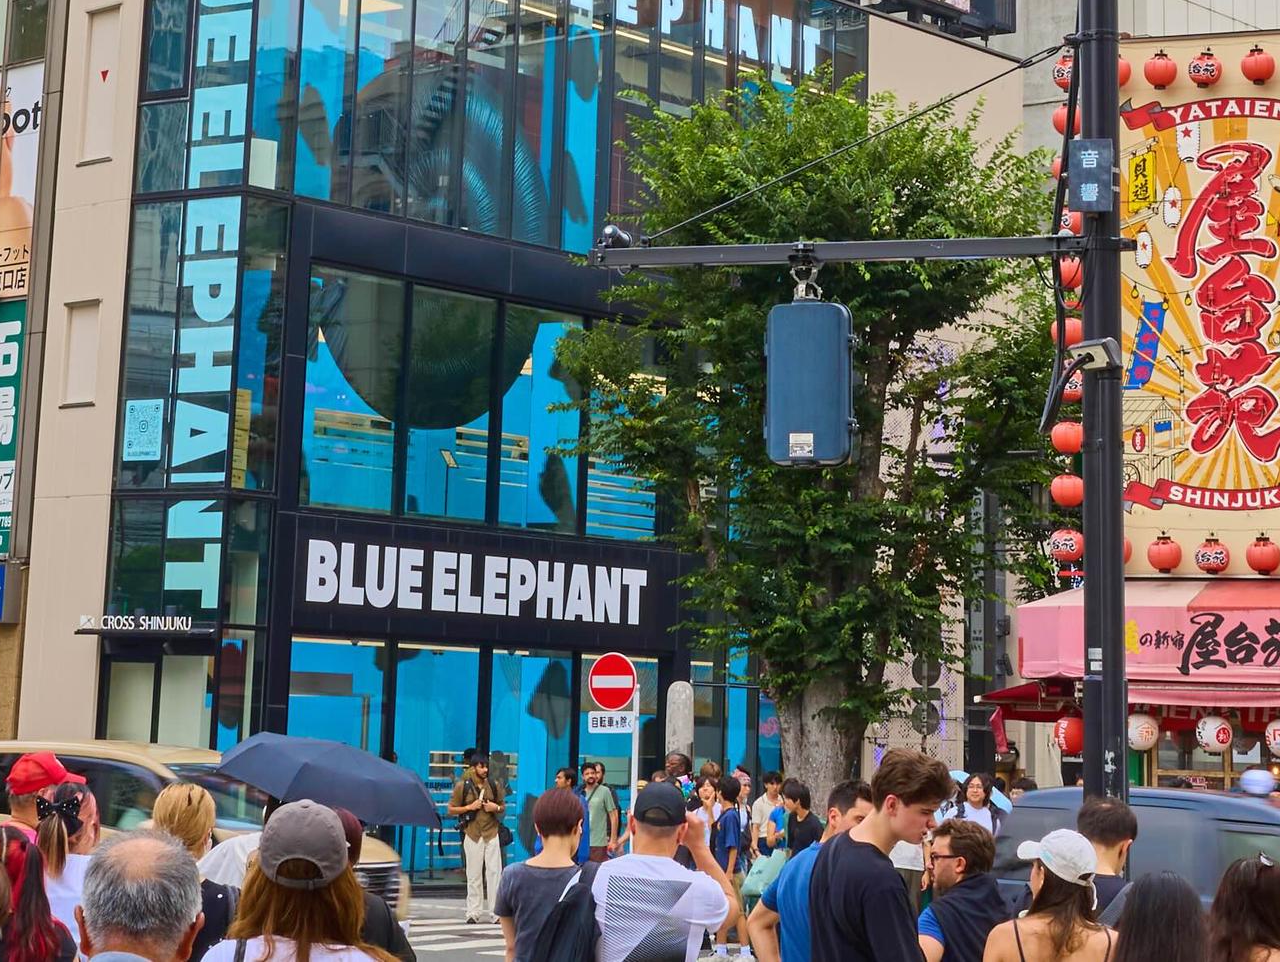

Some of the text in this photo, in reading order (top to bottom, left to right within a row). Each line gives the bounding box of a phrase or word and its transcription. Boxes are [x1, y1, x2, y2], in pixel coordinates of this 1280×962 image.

[1080, 149, 1100, 202] 音響
[306, 539, 649, 626] BLUE ELEPHANT
[100, 615, 192, 631] CROSS SHINJUKU
[591, 715, 632, 728] 自転車を除く
